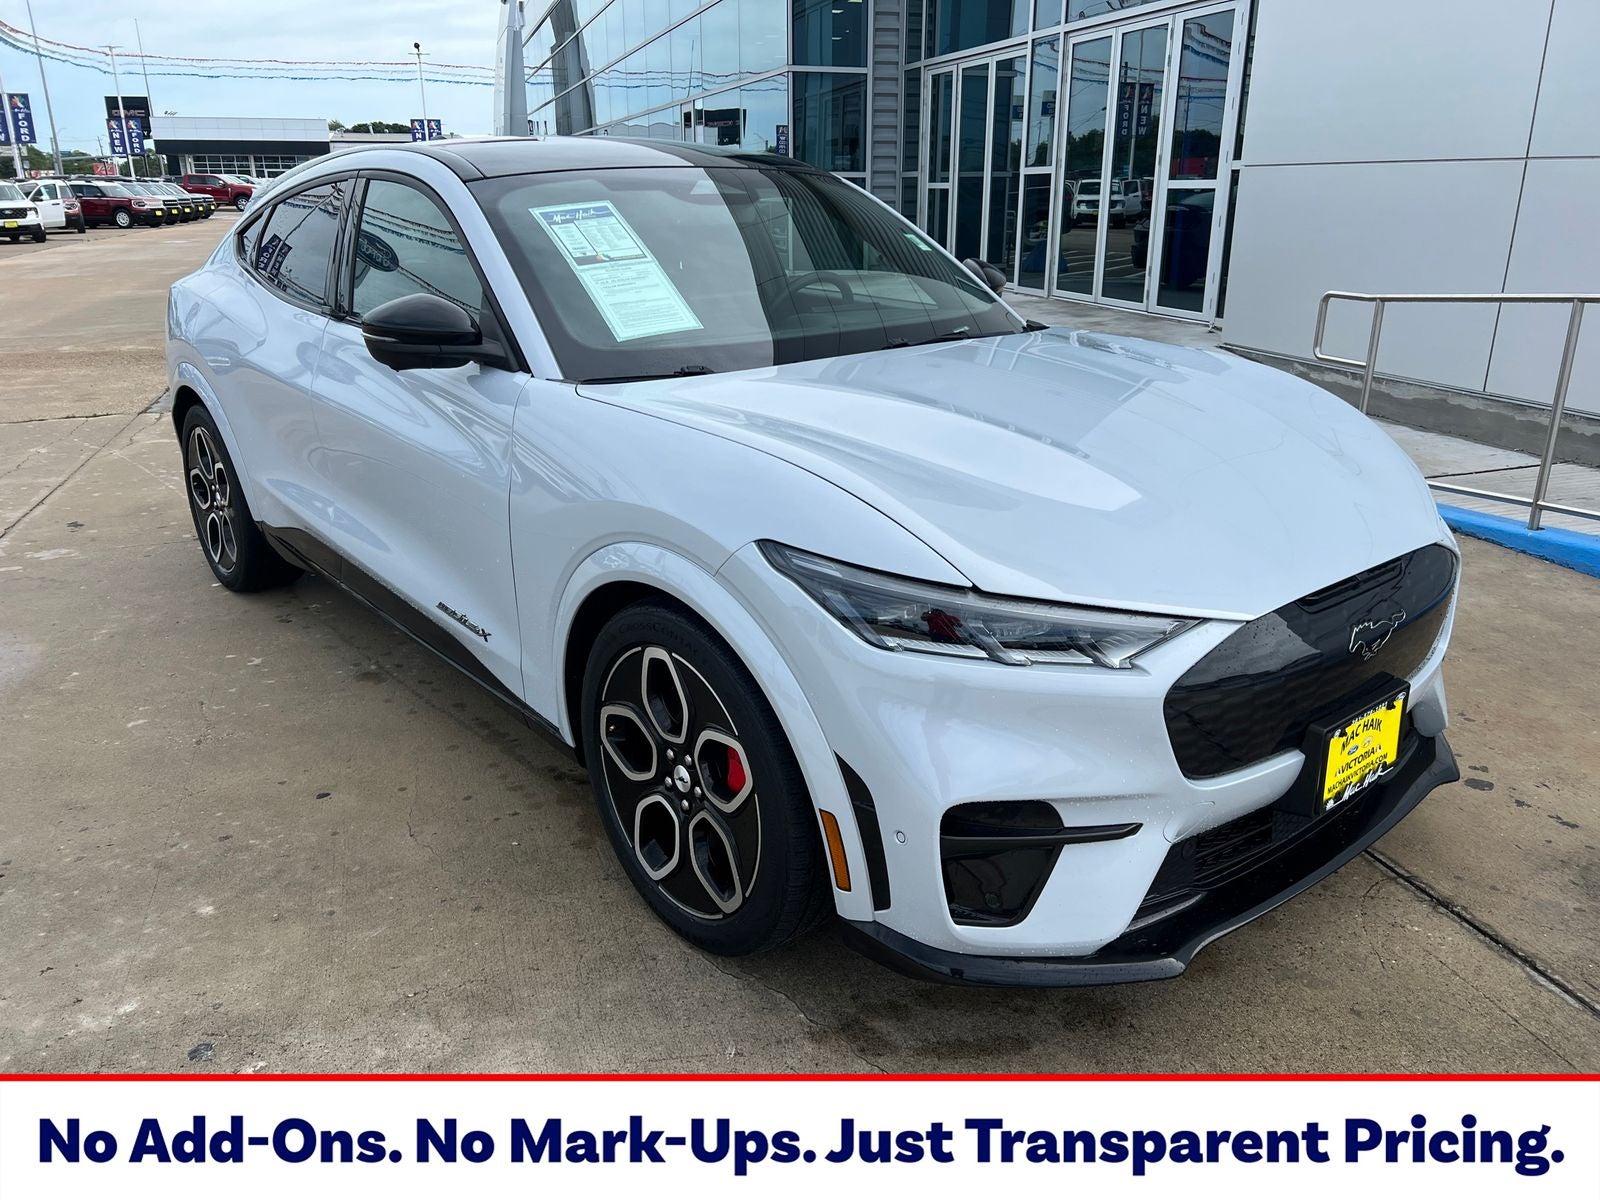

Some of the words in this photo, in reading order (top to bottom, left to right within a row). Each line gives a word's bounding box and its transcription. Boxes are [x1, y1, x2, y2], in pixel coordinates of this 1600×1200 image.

[18, 112, 31, 142] FORD
[112, 132, 123, 153] NEW
[131, 132, 141, 153] FORD
[1340, 723, 1362, 756] MAC
[1362, 718, 1383, 733] HAIK
[1340, 746, 1375, 776] VICTORIA
